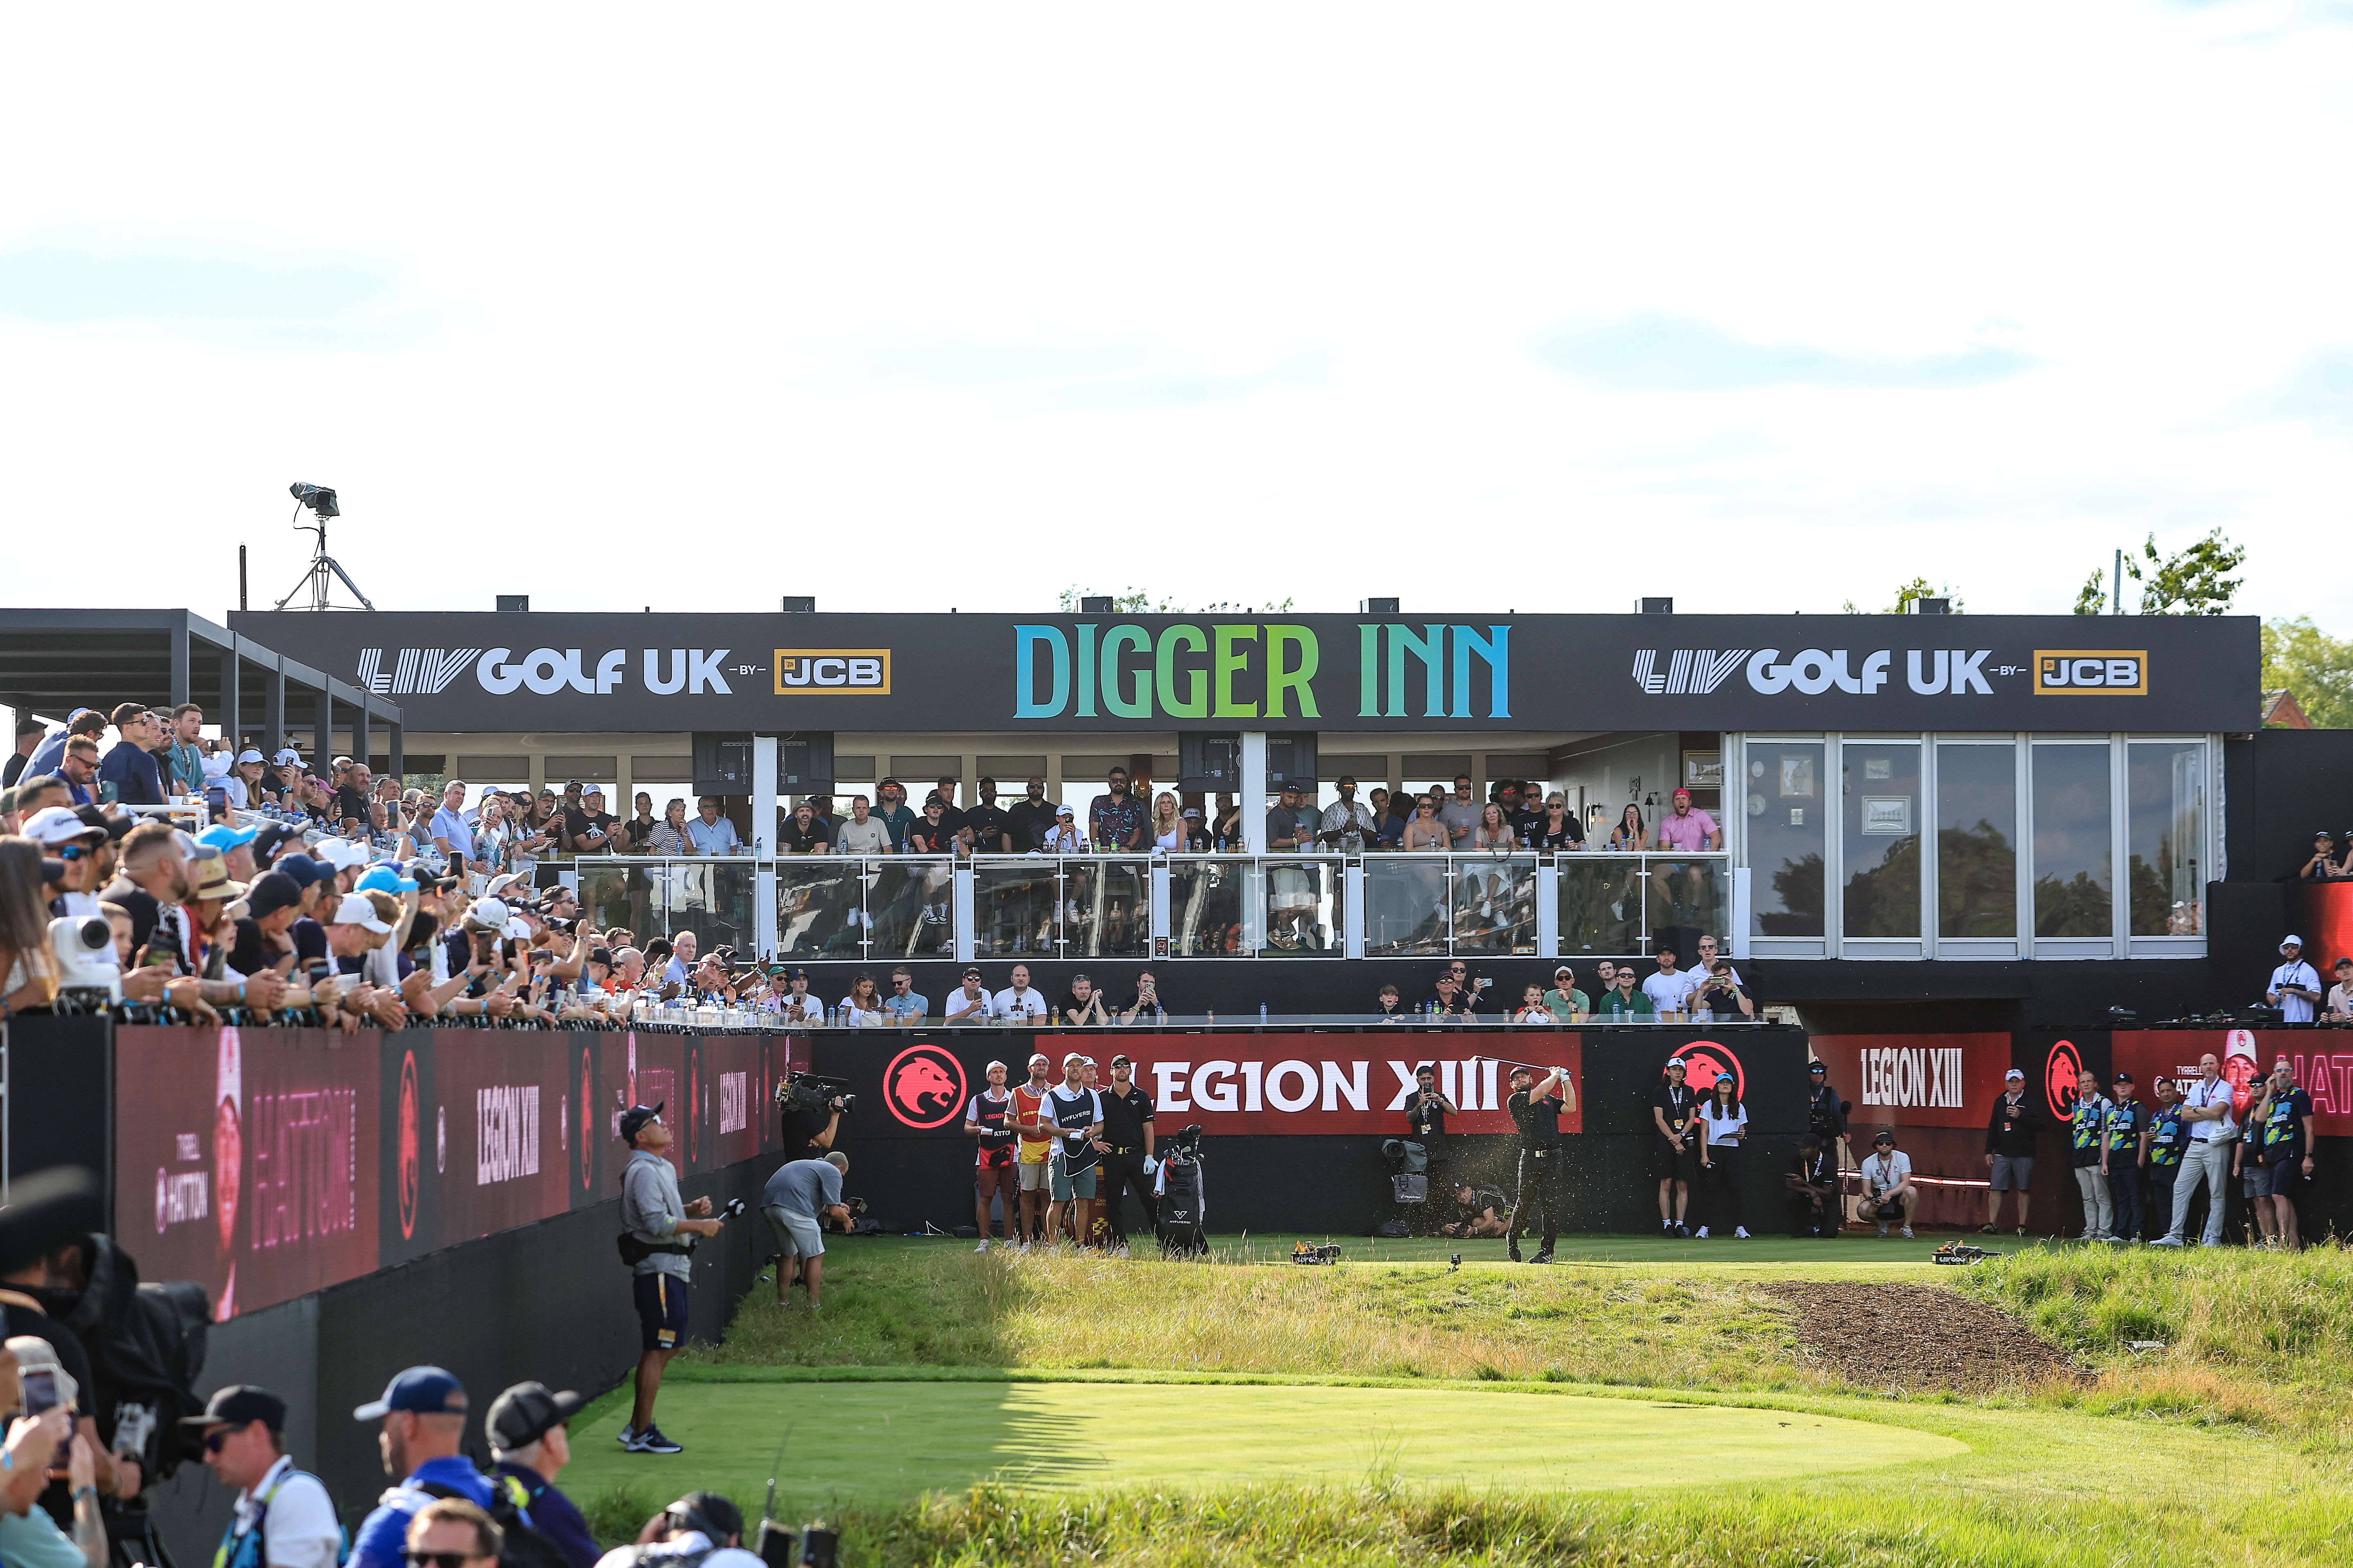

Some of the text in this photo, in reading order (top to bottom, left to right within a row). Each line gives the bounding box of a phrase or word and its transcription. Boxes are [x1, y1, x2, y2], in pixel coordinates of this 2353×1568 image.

[357, 647, 882, 695] LIV GOLF UK BY JCB
[1013, 624, 1512, 718] DIGGER INN
[1632, 648, 2140, 695] LIV GOLF UK BY JCB
[1385, 1060, 1499, 1111] XIII
[1860, 1046, 1964, 1108] LEGION XIII
[2176, 1066, 2204, 1075] TYRRELL
[477, 1084, 520, 1186] LEGION
